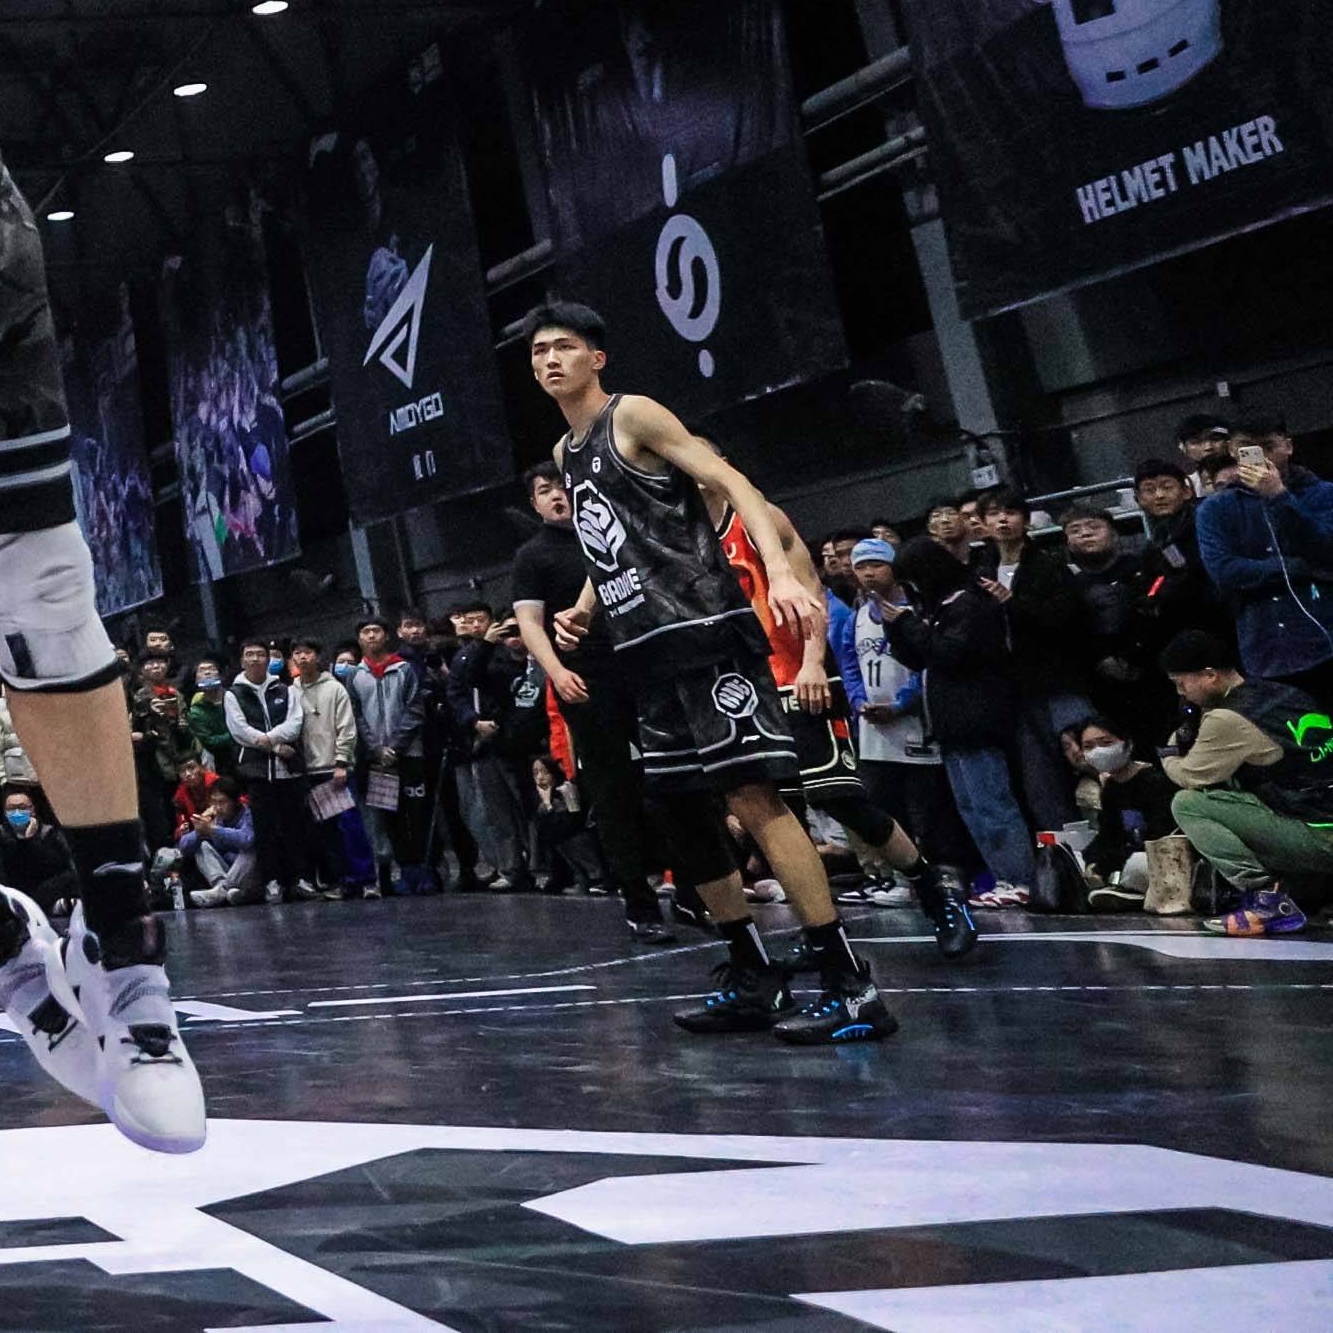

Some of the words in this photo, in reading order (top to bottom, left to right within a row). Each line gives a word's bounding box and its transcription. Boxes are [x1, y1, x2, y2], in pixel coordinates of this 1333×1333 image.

[1076, 152, 1178, 224] HELMET
[1182, 115, 1284, 185] MAKER
[867, 659, 883, 687] 11
